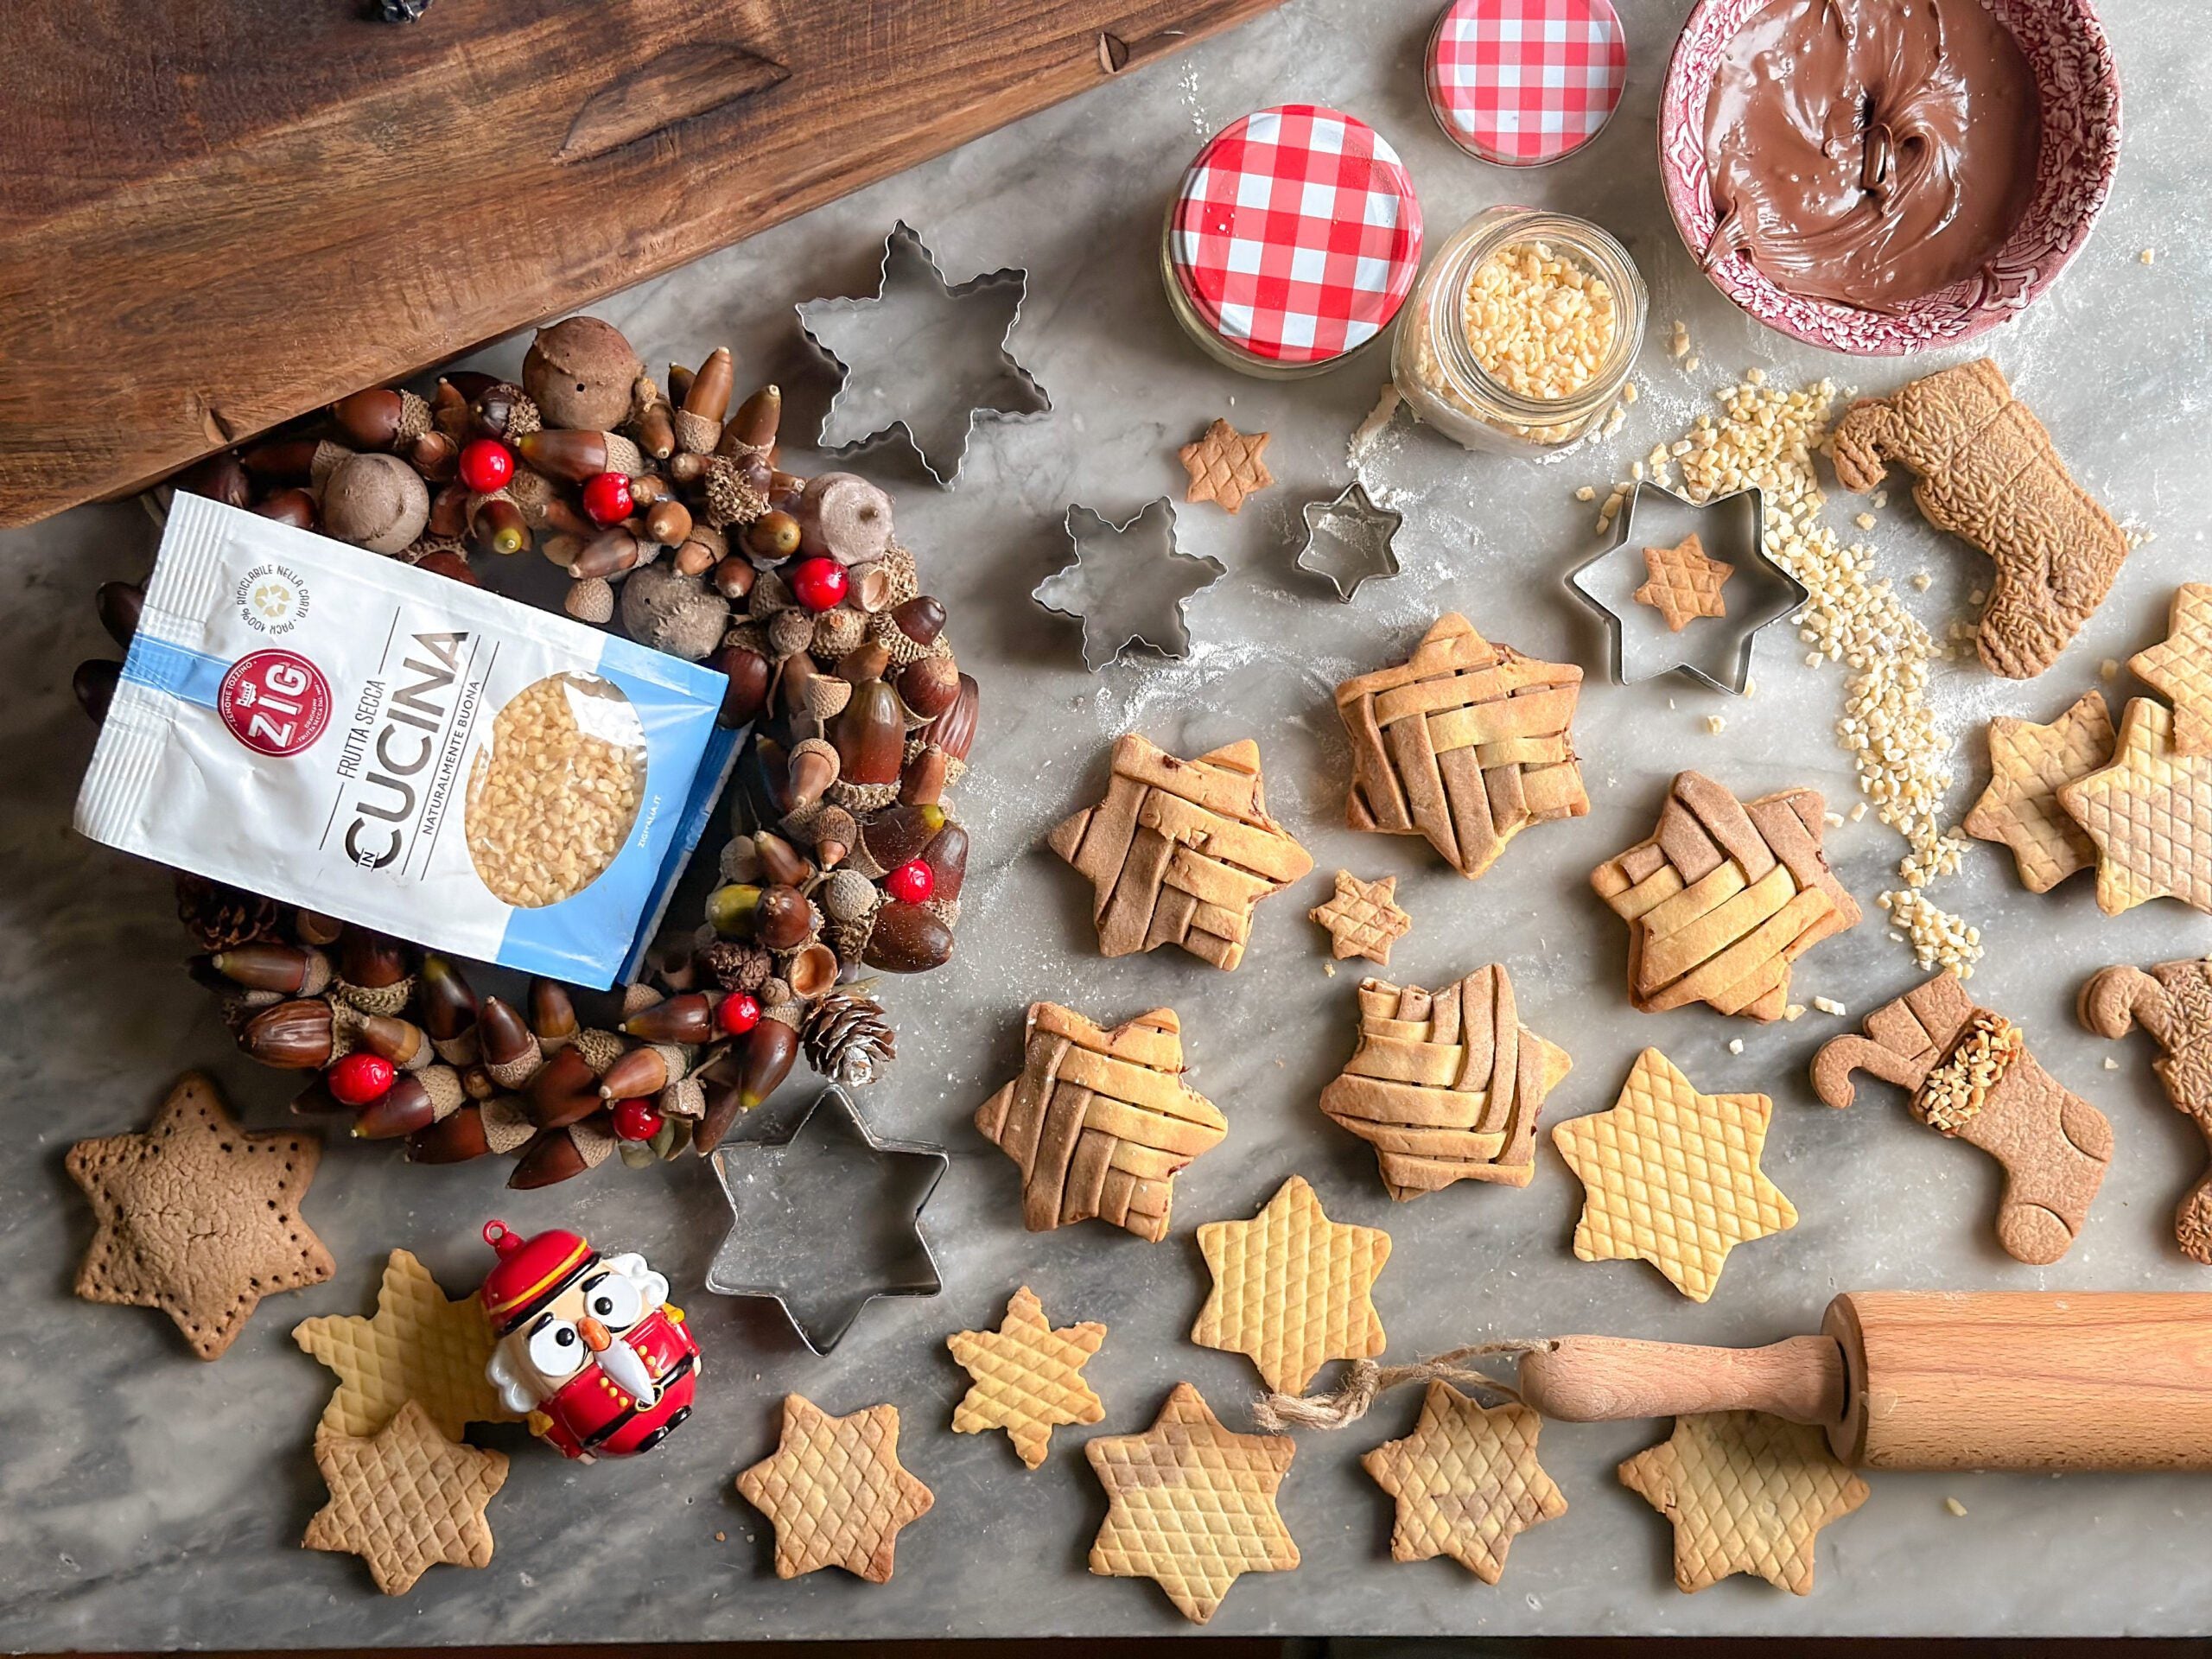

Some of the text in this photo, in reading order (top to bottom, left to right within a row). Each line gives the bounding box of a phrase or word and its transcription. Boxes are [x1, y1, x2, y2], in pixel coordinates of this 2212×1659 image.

[237, 564, 310, 635] PACK 100% RICICLABILE NELLA CARTA
[225, 691, 236, 723] ZENONE
[248, 662, 313, 747] ZIG
[337, 680, 386, 779] FRUTTA SECCA
[345, 632, 469, 869] CUCINA
[423, 681, 480, 836] NATURALMENTE BUONA
[359, 851, 375, 868] IN
